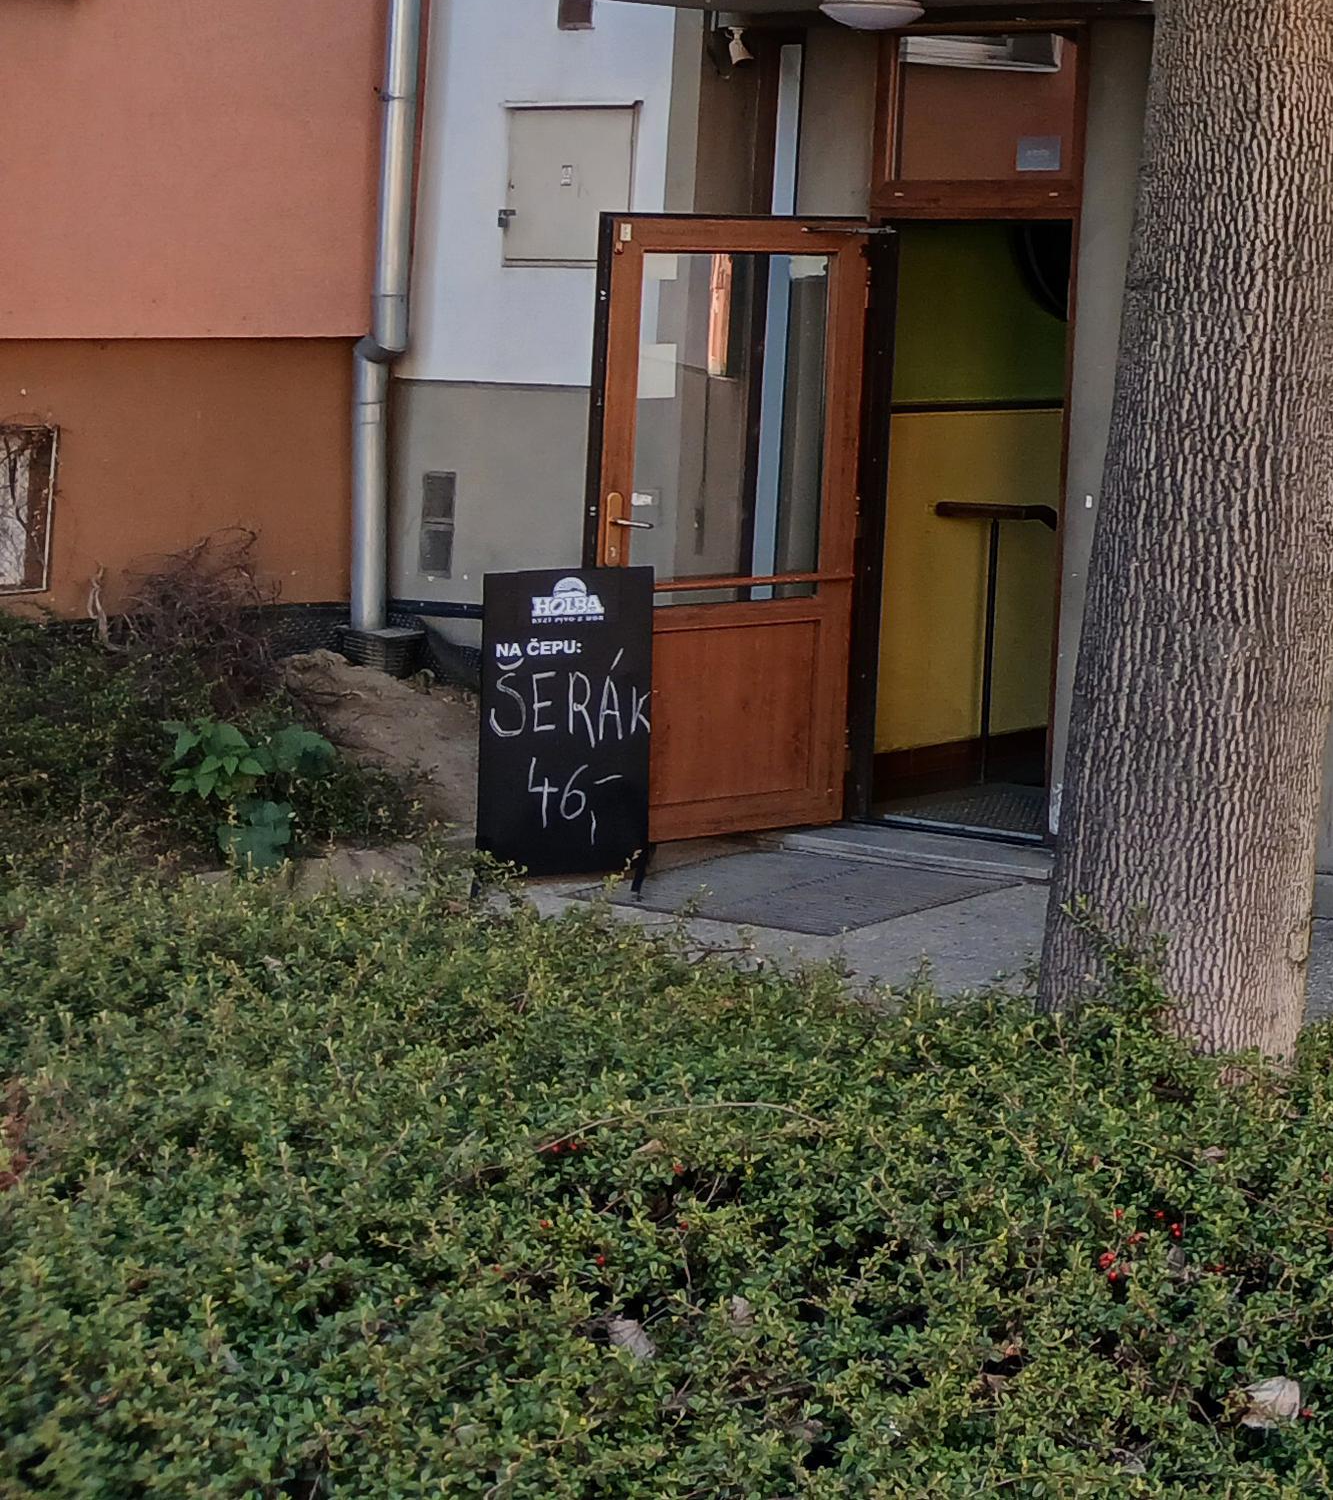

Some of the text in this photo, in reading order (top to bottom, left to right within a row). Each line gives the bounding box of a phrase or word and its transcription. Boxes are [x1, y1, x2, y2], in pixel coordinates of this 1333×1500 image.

[531, 594, 605, 618] HOLBA
[495, 638, 583, 658] NA ČEPU:
[489, 648, 651, 749] ŠERÁK
